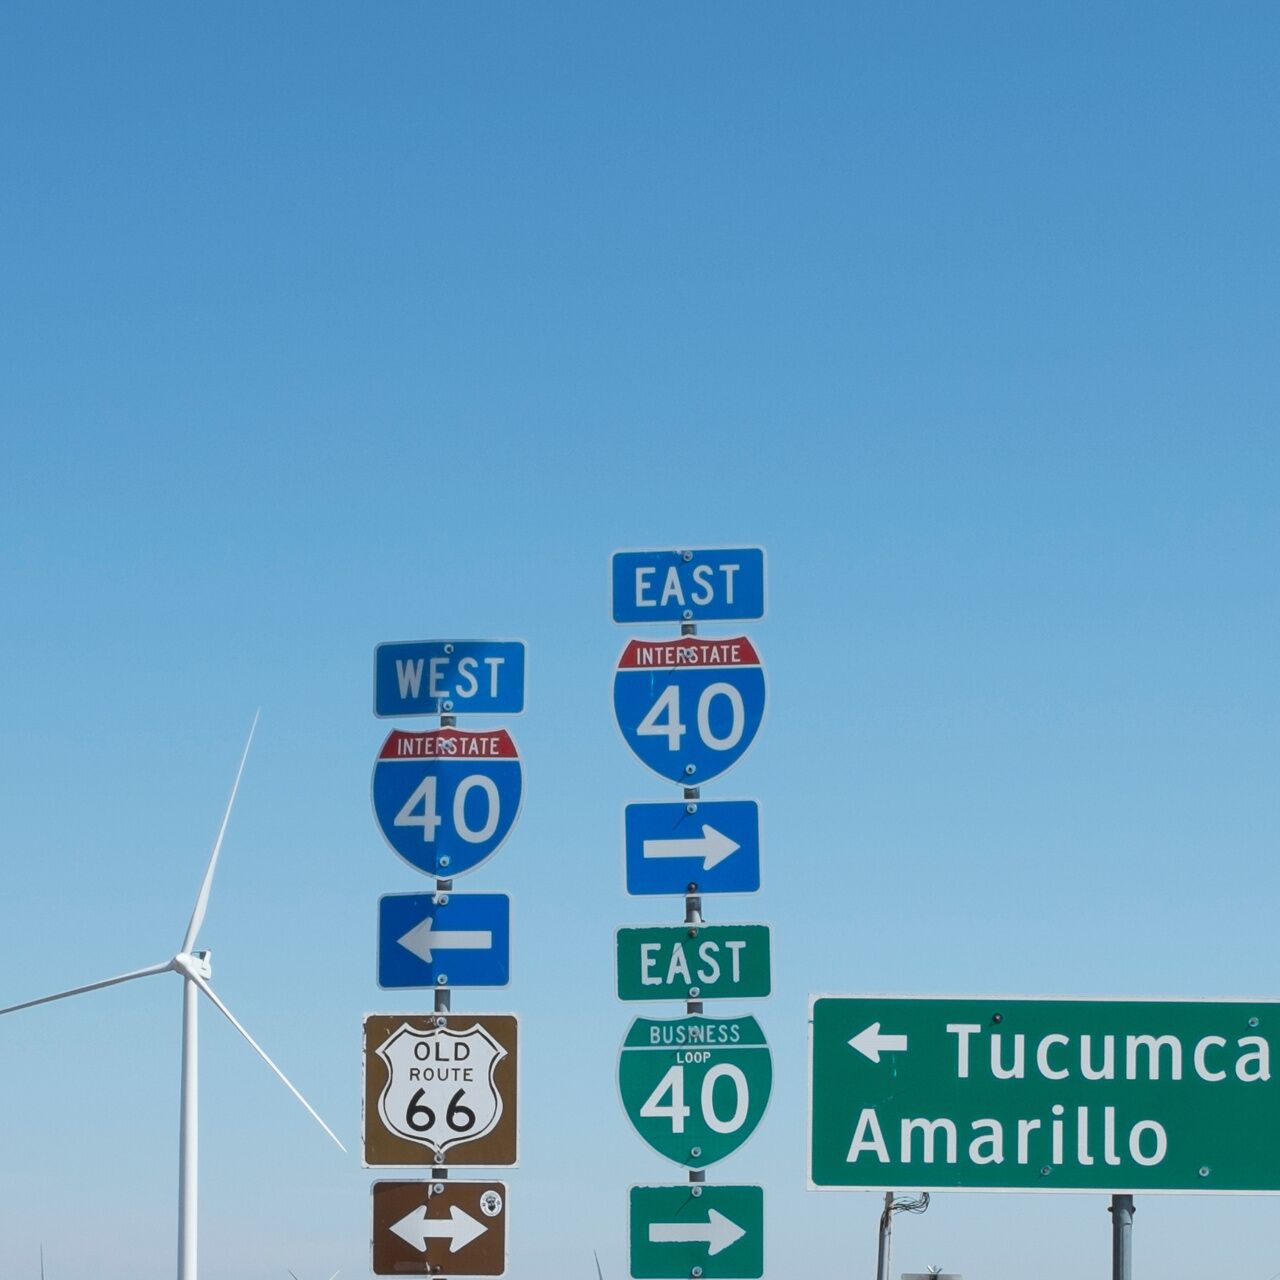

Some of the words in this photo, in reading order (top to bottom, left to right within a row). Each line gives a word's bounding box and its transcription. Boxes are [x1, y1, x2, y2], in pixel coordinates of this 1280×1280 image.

[635, 564, 740, 607] EAST
[636, 645, 741, 665] INTERSTATE
[396, 657, 505, 699] WEST
[637, 682, 745, 751] 40
[397, 737, 500, 755] INTERSTATE
[394, 774, 501, 844] 40
[641, 941, 746, 986] EAST
[414, 1041, 470, 1062] OLD
[650, 1024, 741, 1045] BUSINESS
[409, 1068, 474, 1082] ROUTE
[676, 1051, 711, 1064] LOOP
[406, 1087, 476, 1132] 66
[640, 1063, 750, 1134] 40
[846, 1105, 1168, 1166] Amarillo
